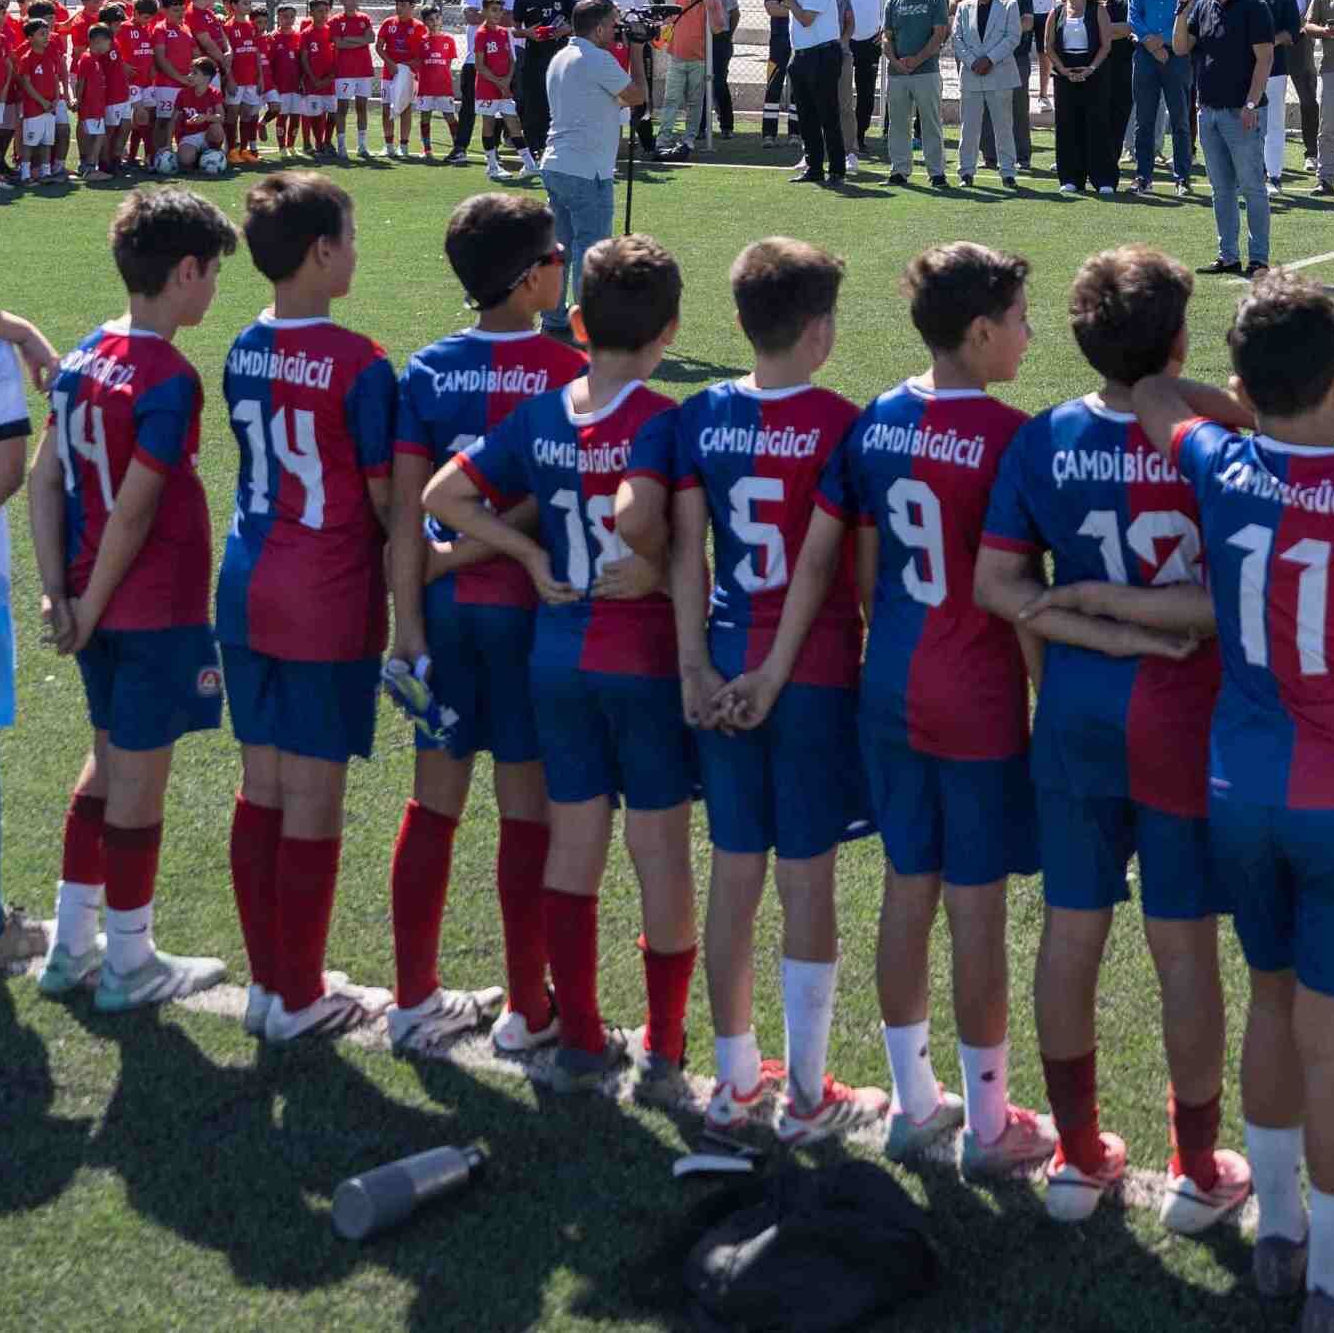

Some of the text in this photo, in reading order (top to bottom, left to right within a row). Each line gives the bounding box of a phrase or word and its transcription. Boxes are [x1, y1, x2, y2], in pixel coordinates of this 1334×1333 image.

[130, 30, 140, 39] 10
[310, 42, 318, 52] 3
[160, 100, 172, 111] 23
[432, 365, 548, 400] ÇAMDİBİGÜCÜ
[52, 390, 116, 513] 14
[699, 424, 821, 458] ÇAMDİBİGÜCÜ
[862, 422, 985, 469] ÇAMDİBİGÜCÜ
[232, 399, 326, 531] 14
[1052, 446, 1190, 488] ÇAMDİBİG
[729, 476, 788, 593] 5
[886, 477, 948, 607] 9
[1226, 523, 1332, 676] 11
